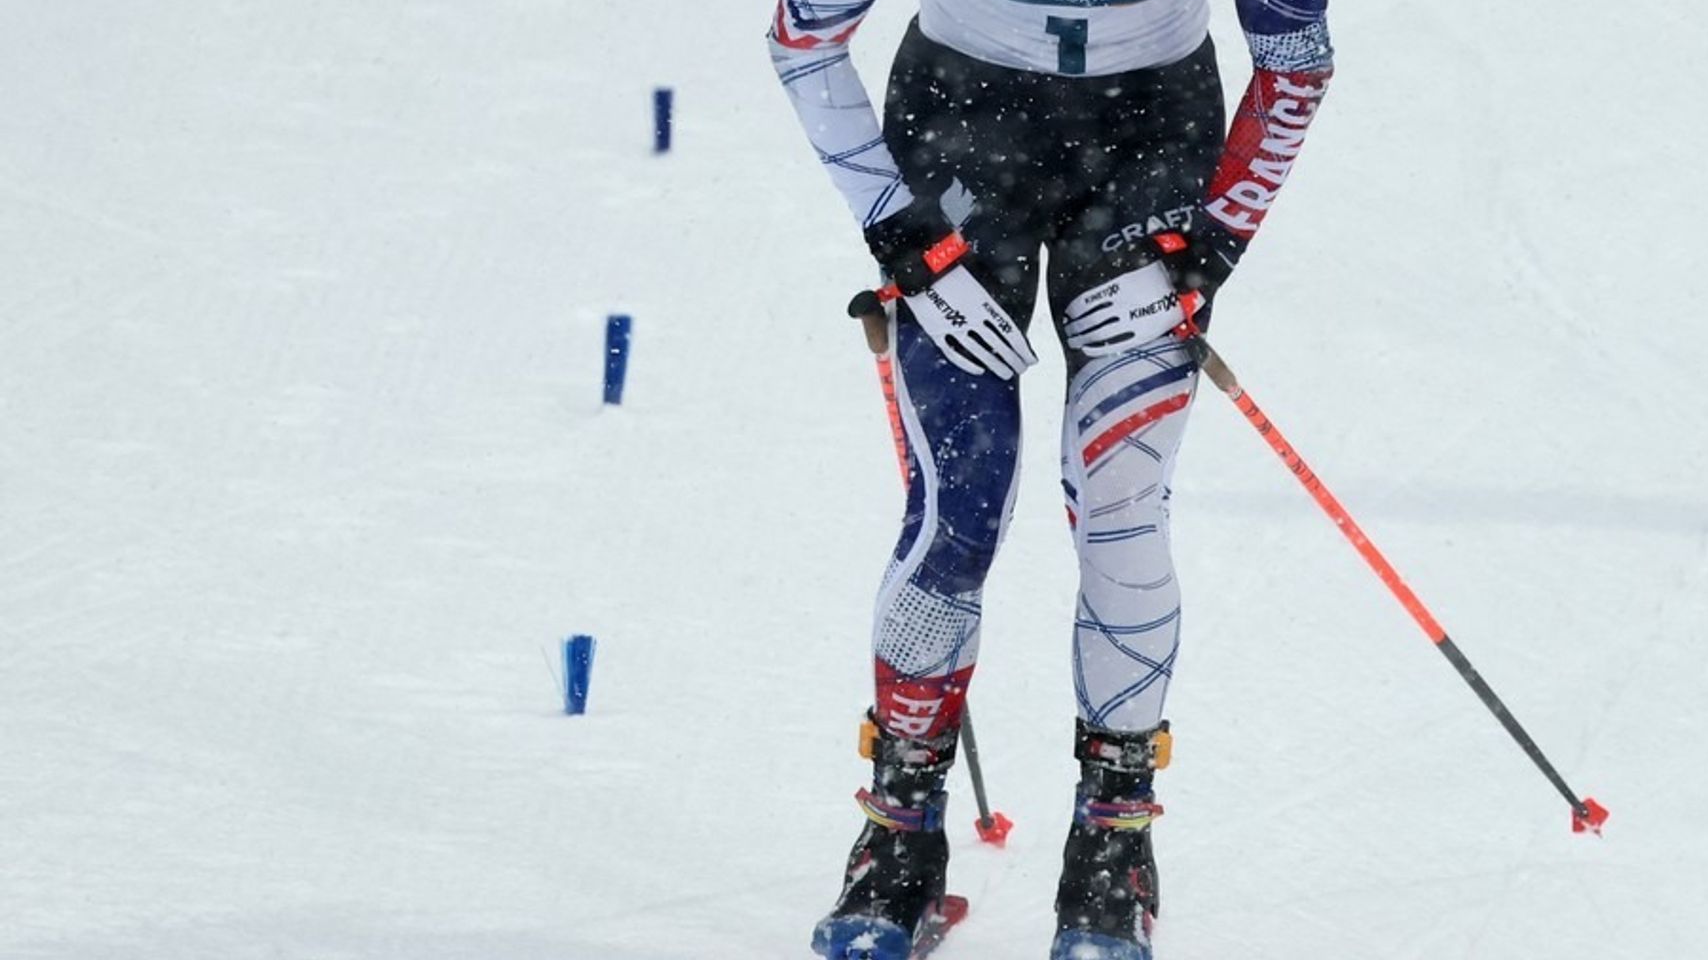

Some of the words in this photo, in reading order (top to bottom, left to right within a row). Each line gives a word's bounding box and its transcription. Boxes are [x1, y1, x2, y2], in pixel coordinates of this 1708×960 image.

[1045, 15, 1089, 74] 1
[1101, 204, 1195, 253] CRAFT
[886, 692, 944, 738] FR
